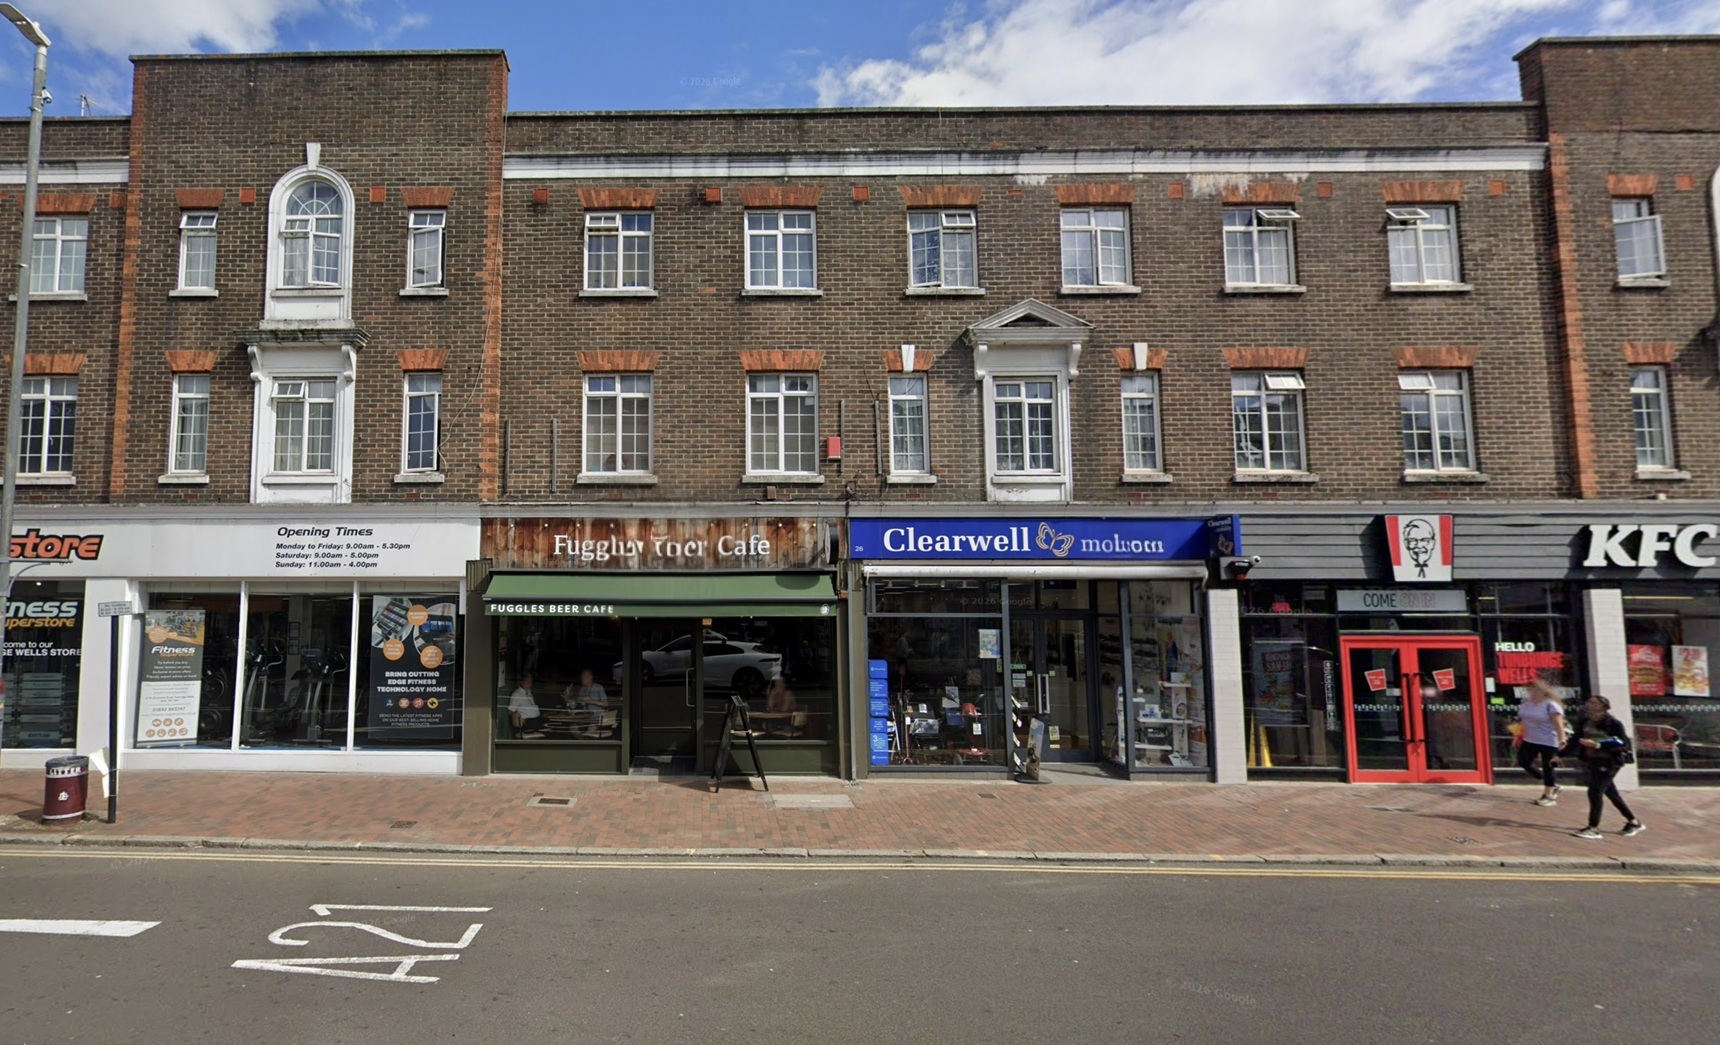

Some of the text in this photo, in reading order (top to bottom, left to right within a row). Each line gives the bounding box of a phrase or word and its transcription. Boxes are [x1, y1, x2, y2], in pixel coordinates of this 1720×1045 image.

[277, 526, 373, 538] Opening Times
[883, 526, 1032, 552] Clearwell
[718, 534, 770, 556] Cafe
[1583, 524, 1718, 567] KFC
[1363, 593, 1397, 608] COME
[6, 602, 78, 617] ness
[490, 604, 614, 614] FUGGLES BEER CAFE
[1494, 642, 1535, 652] HELLO
[231, 904, 494, 983] A21
